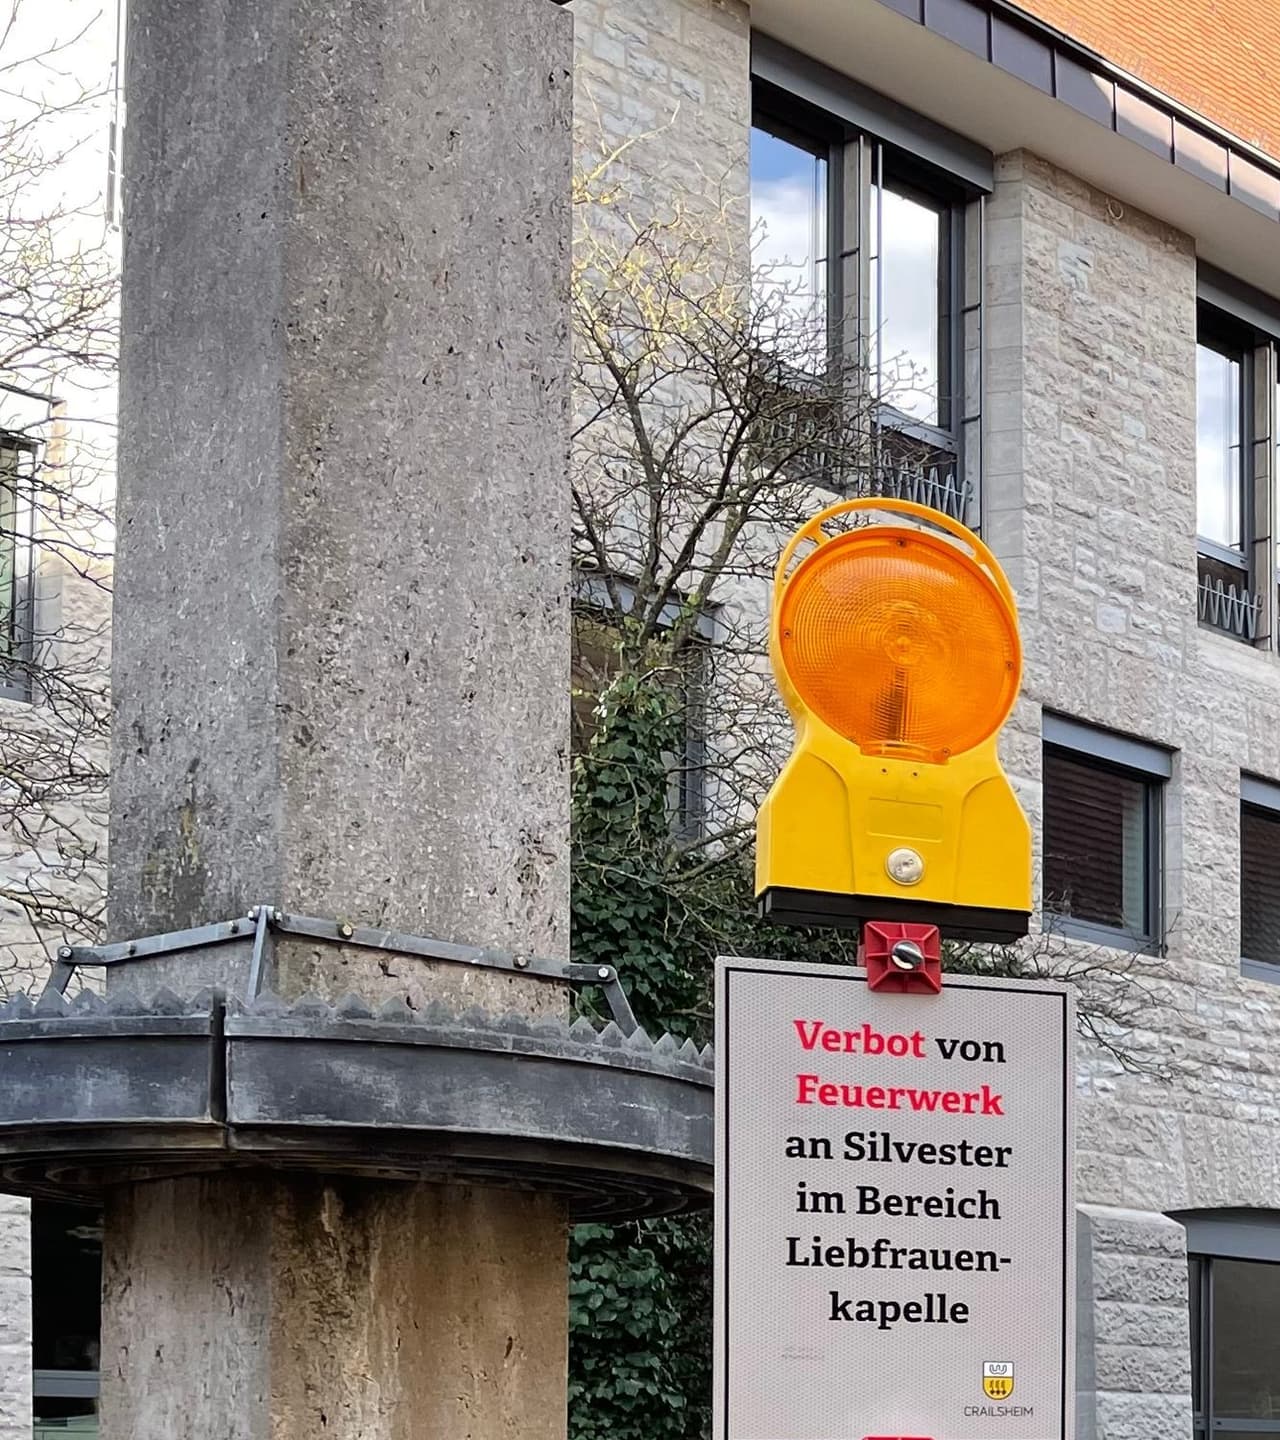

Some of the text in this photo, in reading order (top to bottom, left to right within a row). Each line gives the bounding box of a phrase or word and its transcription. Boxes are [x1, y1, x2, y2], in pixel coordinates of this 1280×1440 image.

[793, 1019, 1007, 1064] Verbot von
[795, 1073, 1006, 1116] Feuerwerk
[785, 1131, 1012, 1168] an Silvester
[796, 1181, 1002, 1221] im Bereich
[785, 1237, 1012, 1273] Liebfrauen-
[828, 1291, 970, 1330] kapelle
[963, 1405, 1034, 1417] CRAILSHEIM
